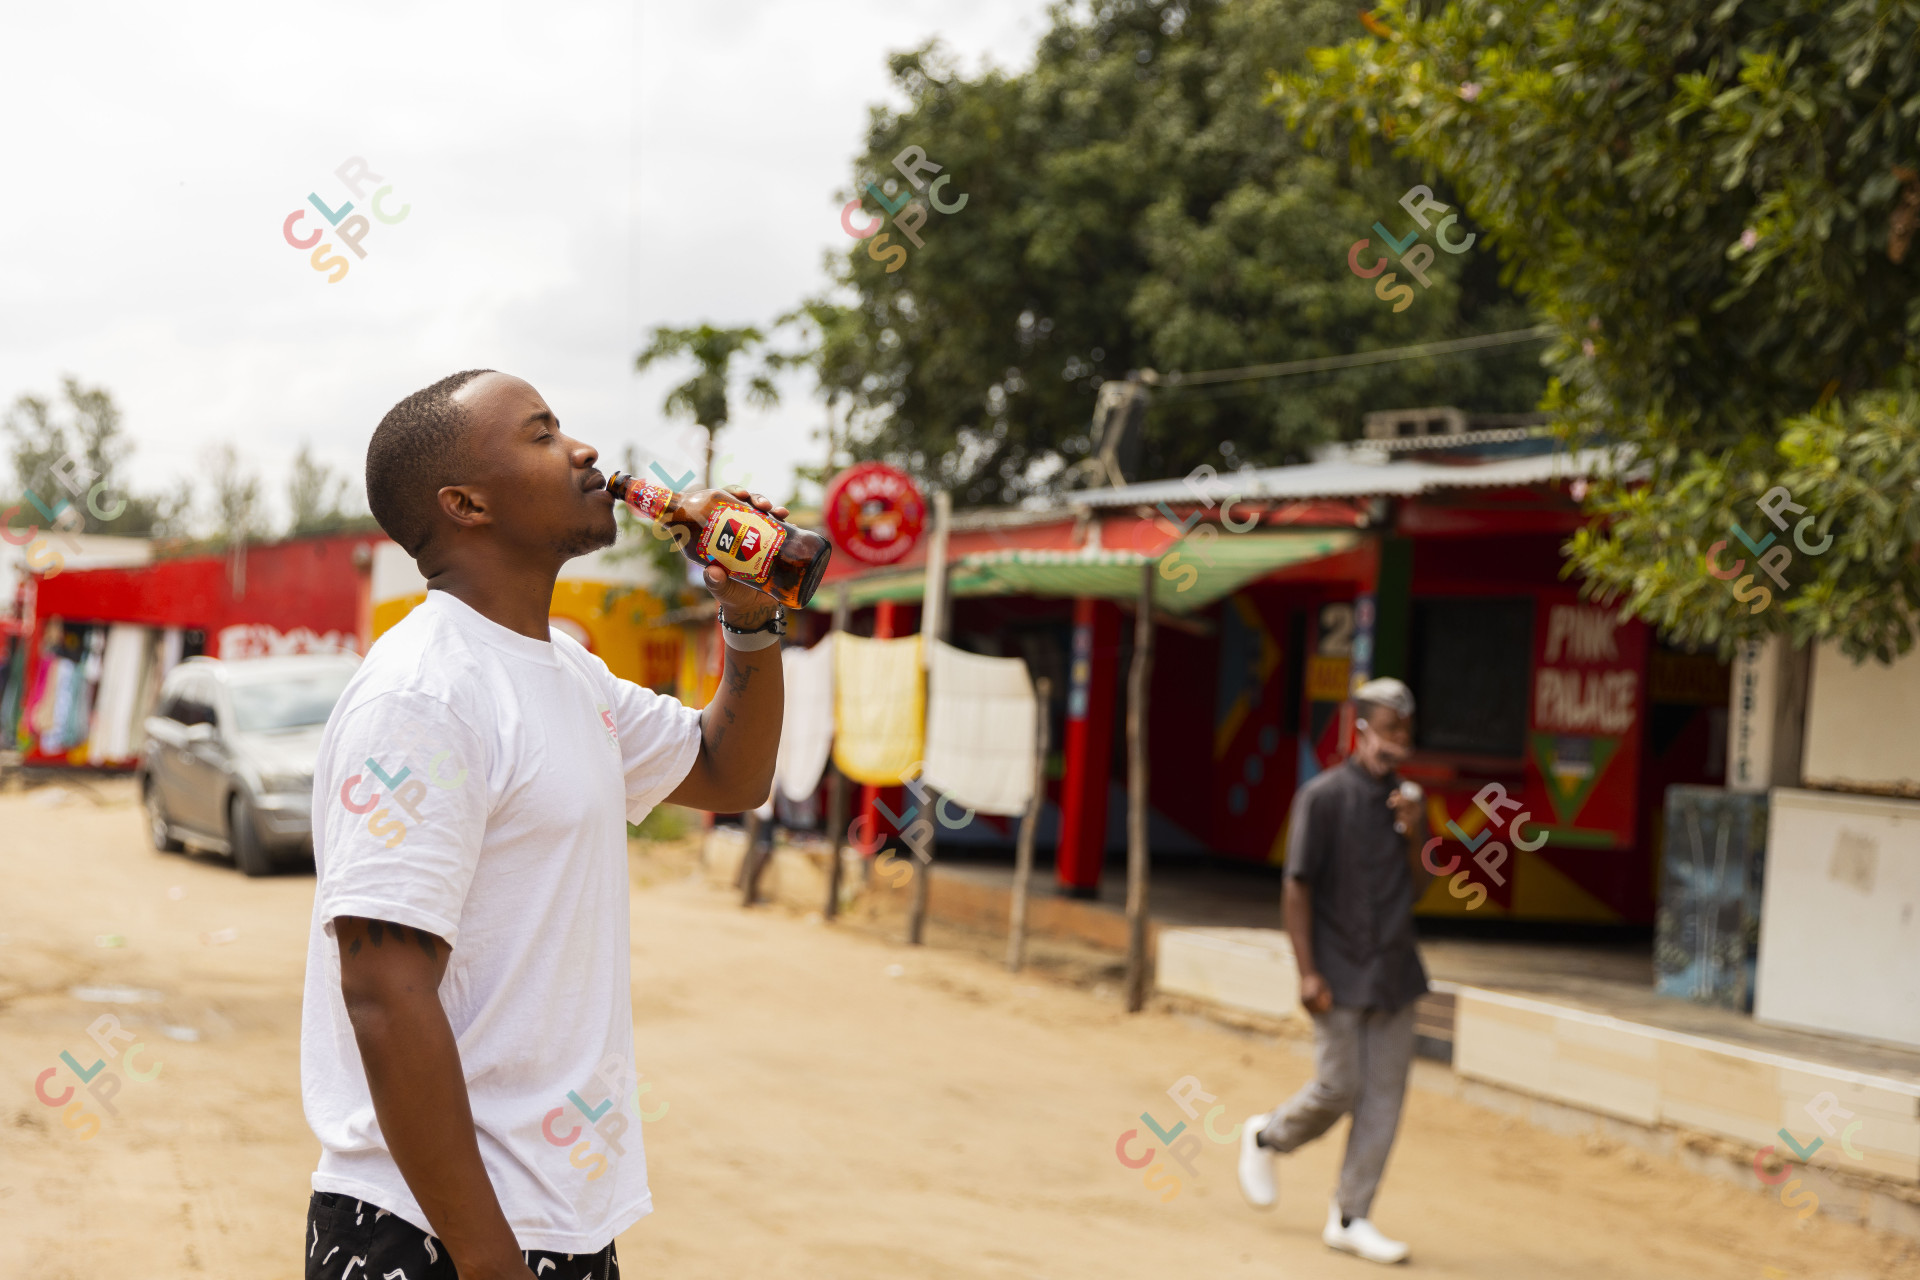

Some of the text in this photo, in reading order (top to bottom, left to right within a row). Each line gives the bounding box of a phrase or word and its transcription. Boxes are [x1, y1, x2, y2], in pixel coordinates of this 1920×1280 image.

[719, 533, 735, 550] 2
[741, 529, 760, 551] M
[1544, 604, 1619, 664] PINK
[1535, 667, 1638, 733] PALACE
